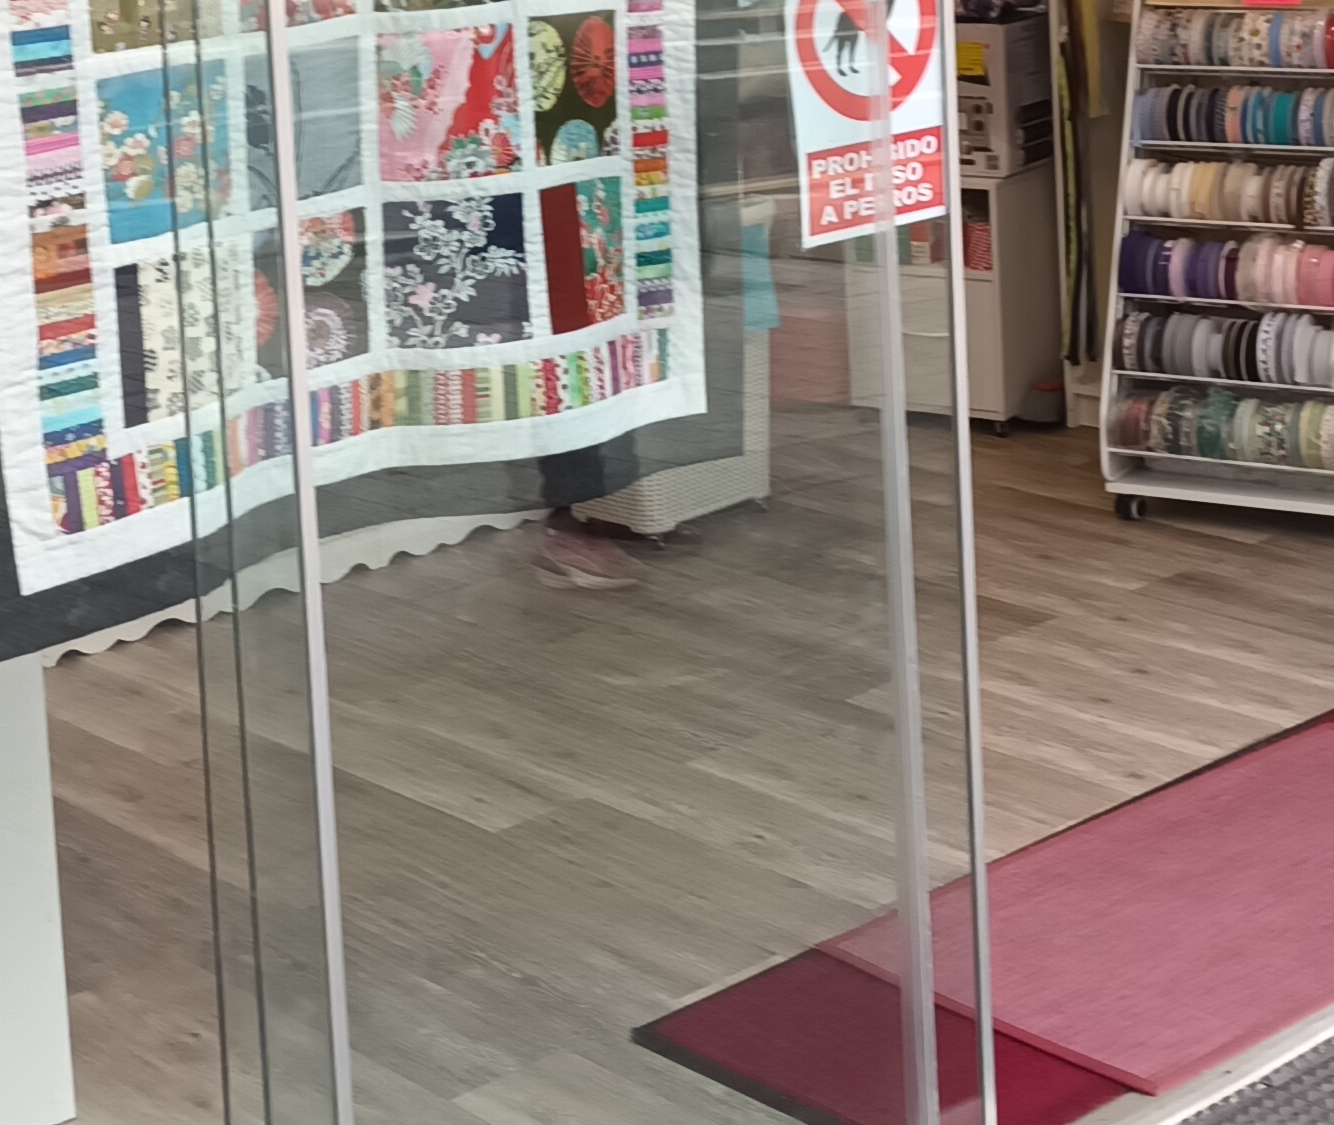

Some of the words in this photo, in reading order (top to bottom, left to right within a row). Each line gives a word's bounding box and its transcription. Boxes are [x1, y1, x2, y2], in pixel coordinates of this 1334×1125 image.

[811, 135, 938, 179] PROHBIDO
[829, 177, 860, 199] EL
[864, 162, 924, 191] PSO
[820, 205, 839, 225] A
[843, 183, 934, 220] PEROS
